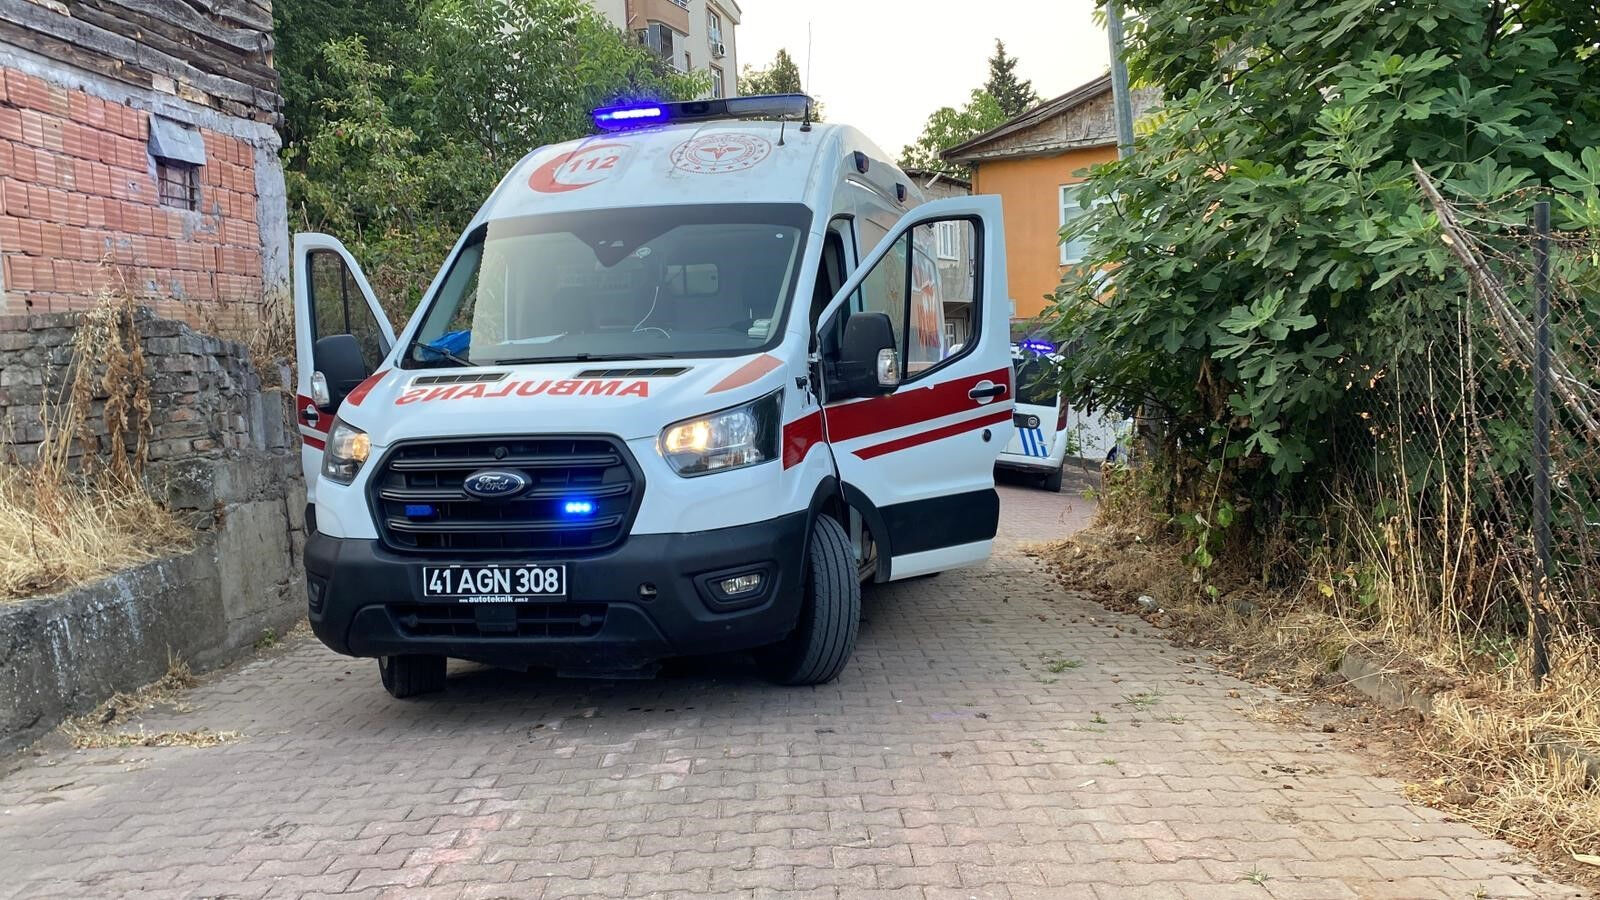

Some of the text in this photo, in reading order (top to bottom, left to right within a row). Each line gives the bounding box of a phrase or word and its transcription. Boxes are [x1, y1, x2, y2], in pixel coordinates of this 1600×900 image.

[569, 155, 620, 173] 112
[475, 475, 509, 490] Ford
[429, 568, 559, 593] 41 AGN 308
